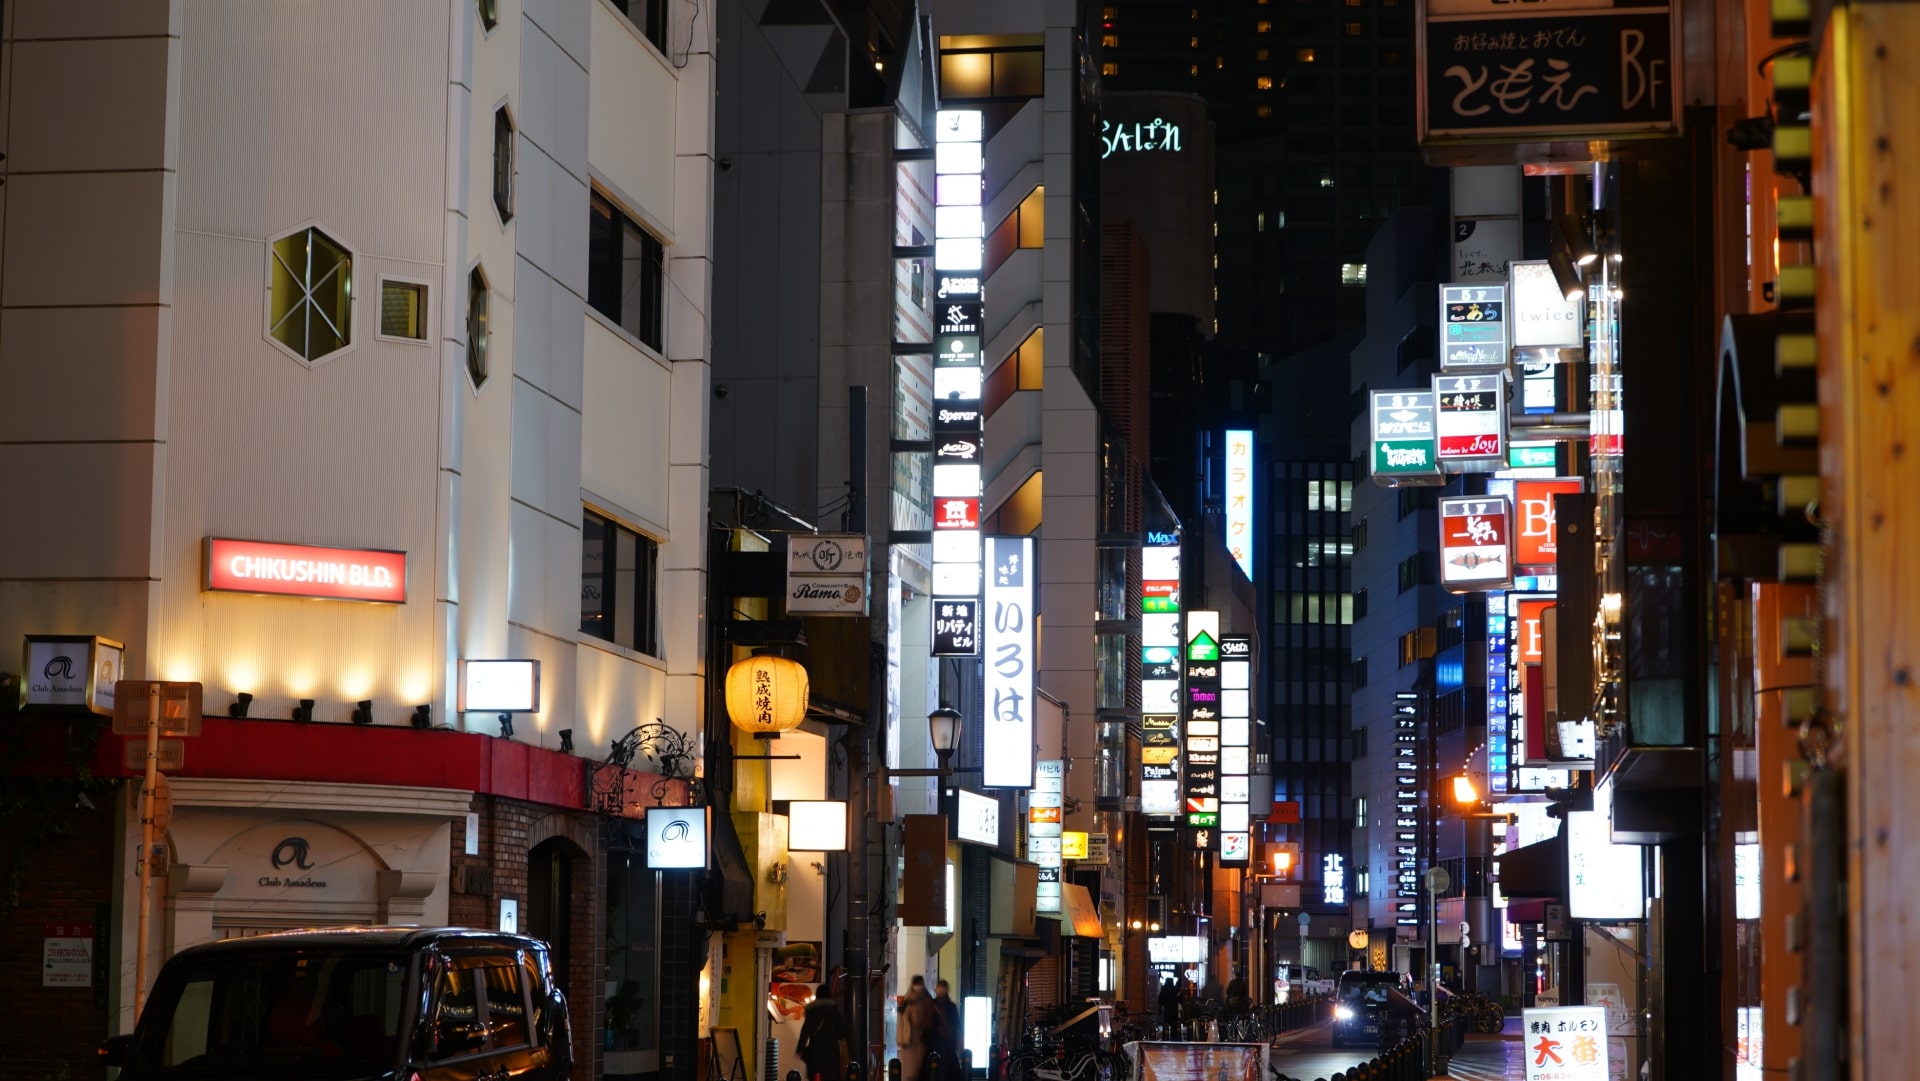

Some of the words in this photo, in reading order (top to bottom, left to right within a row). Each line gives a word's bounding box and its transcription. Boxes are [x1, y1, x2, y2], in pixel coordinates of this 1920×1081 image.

[1453, 27, 1586, 51] お好み焼とおでん
[1443, 57, 1599, 117] ともえ
[1450, 303, 1498, 321] こあら
[1520, 307, 1575, 321] twice
[1469, 435, 1498, 454] Joy
[230, 555, 345, 585] CHIKUSHIN
[349, 564, 393, 588] BLD.
[792, 583, 841, 600] Ramo
[941, 605, 968, 617] 新地
[952, 636, 973, 648] ビル
[993, 600, 1024, 722] いろは
[32, 684, 49, 693] Club
[755, 669, 772, 725] 熟成焼肉
[1143, 765, 1171, 776] Palms
[258, 877, 281, 887] Club
[283, 877, 327, 888] Amadeus
[1323, 853, 1344, 903] 北新地
[1530, 1021, 1551, 1034] 焼肉
[1557, 1019, 1599, 1033] ホルモン
